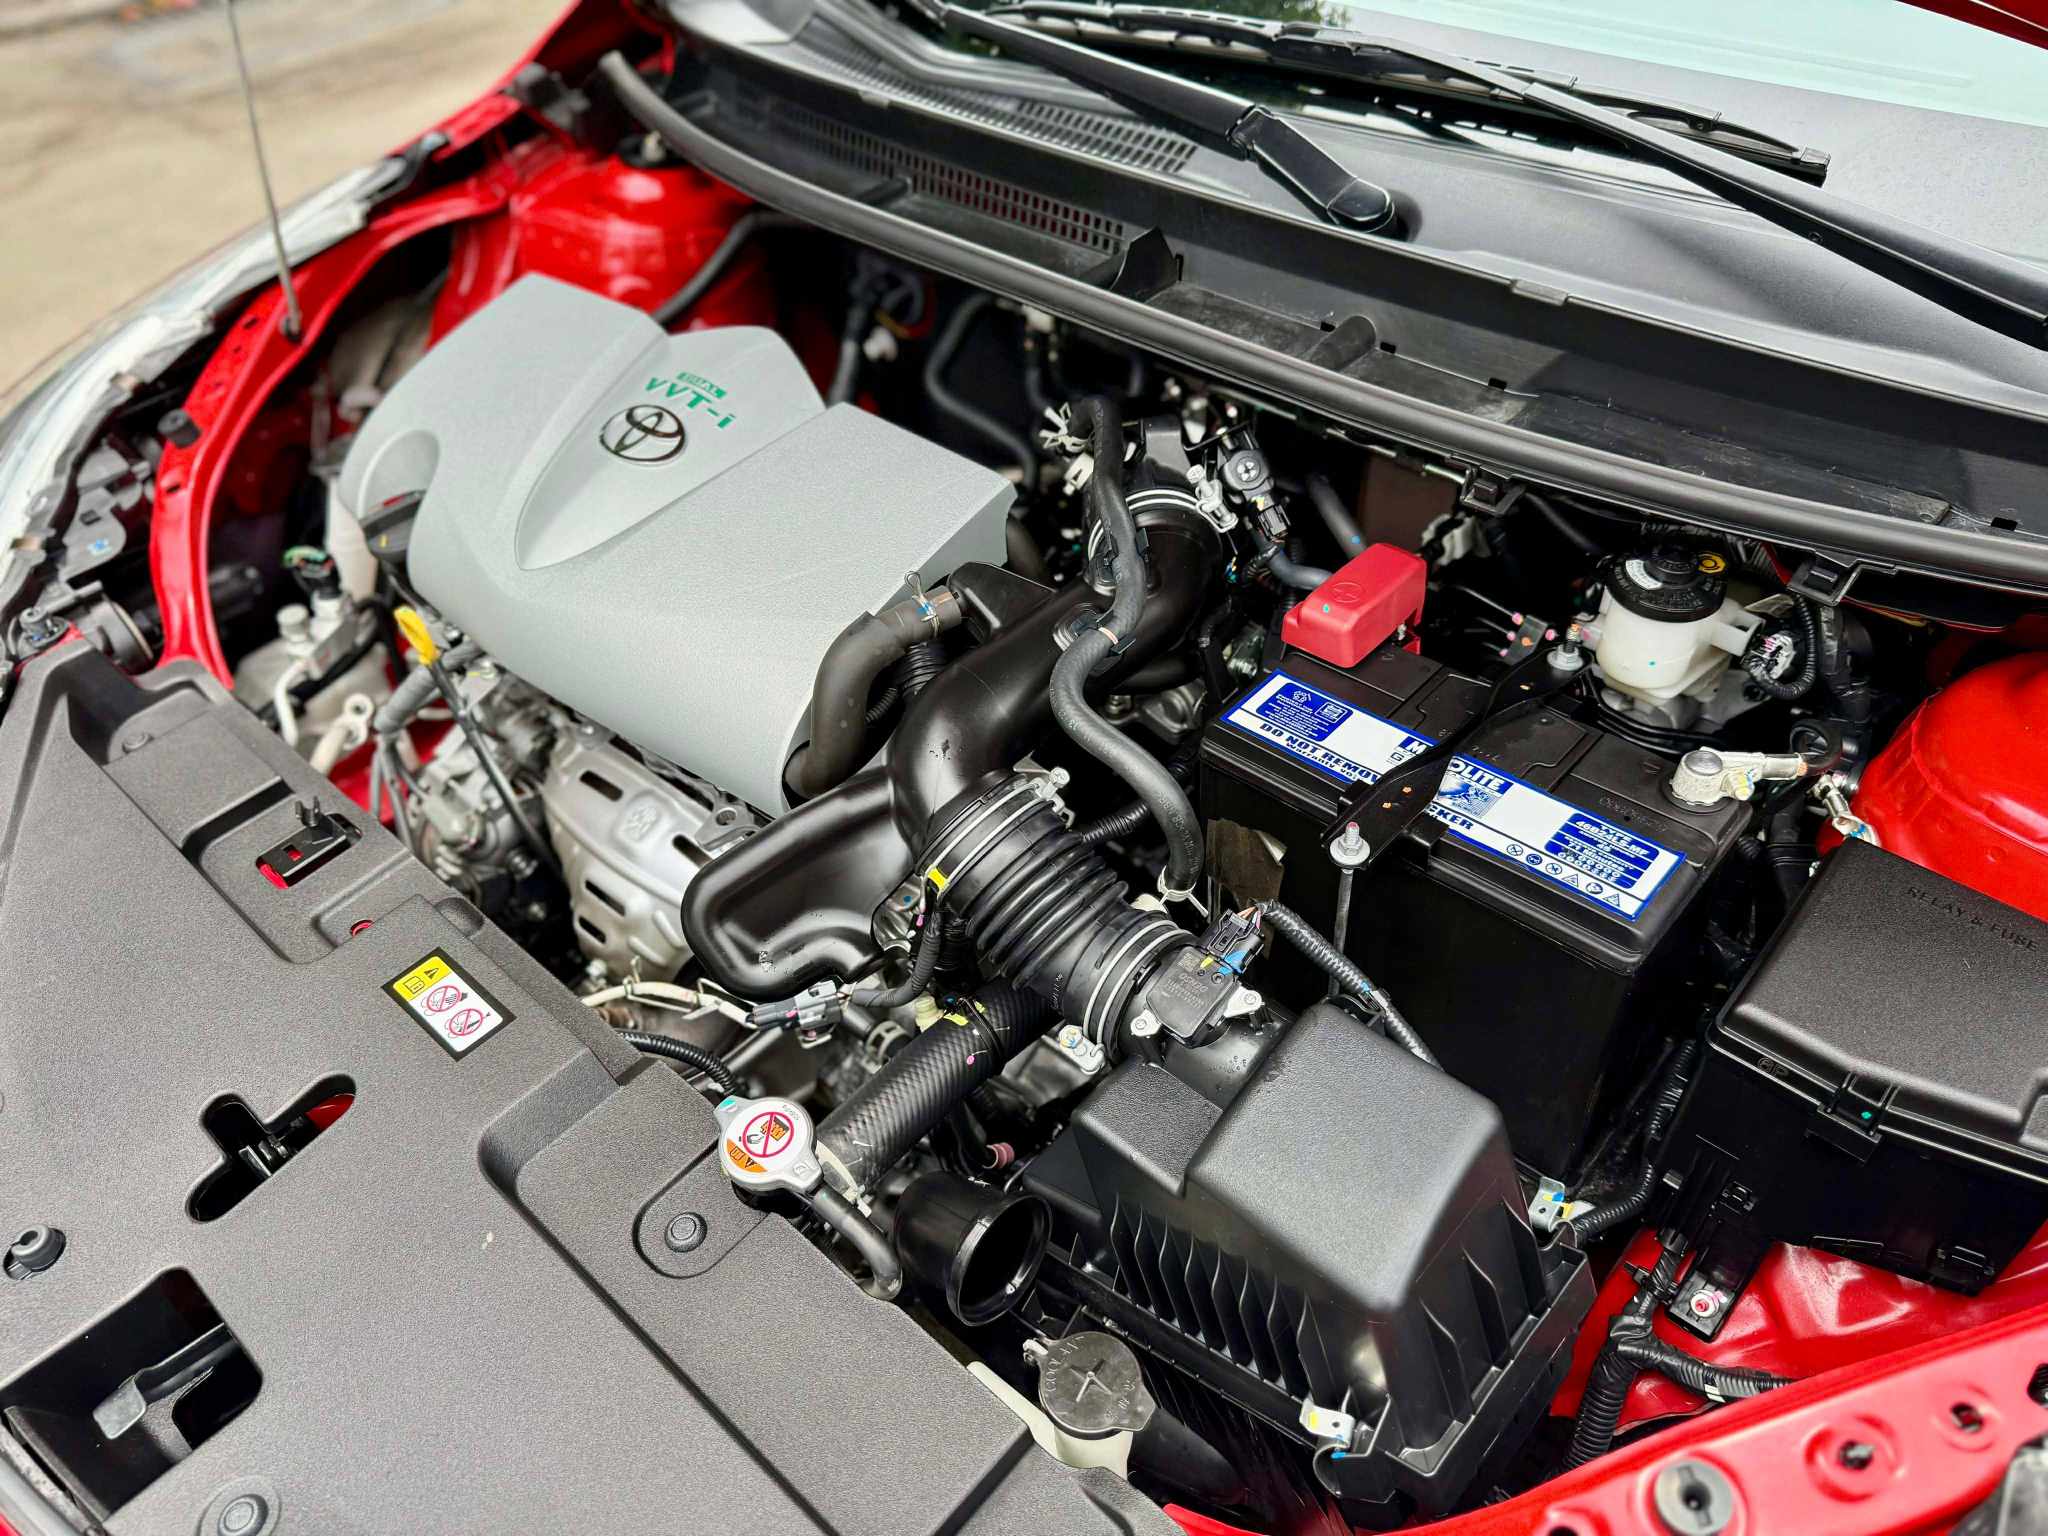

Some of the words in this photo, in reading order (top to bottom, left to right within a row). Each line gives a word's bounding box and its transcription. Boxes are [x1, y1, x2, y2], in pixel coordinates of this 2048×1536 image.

[644, 376, 737, 430] VVT-i
[1258, 722, 1286, 738] DO
[1285, 734, 1321, 754] NOT
[1321, 751, 1382, 785] REMOV
[1905, 885, 1967, 918] RELAY
[1989, 923, 2039, 952] FUSE
